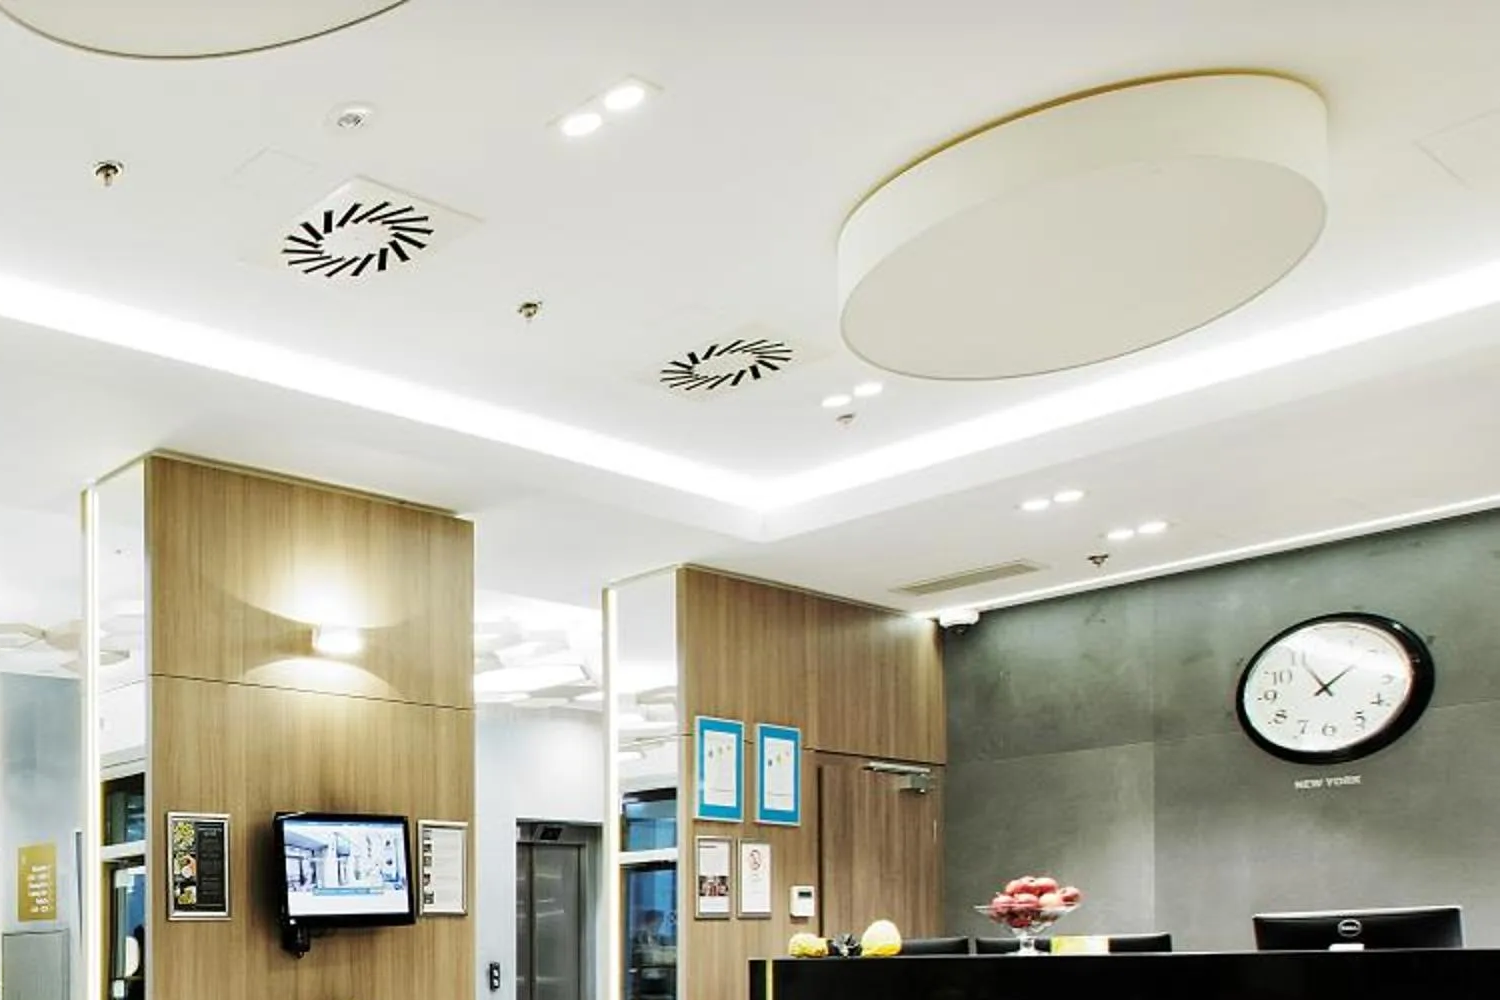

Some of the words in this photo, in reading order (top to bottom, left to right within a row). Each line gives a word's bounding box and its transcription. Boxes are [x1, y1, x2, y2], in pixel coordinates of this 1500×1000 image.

[1272, 669, 1293, 686] 10
[1263, 689, 1278, 701] 9
[1371, 692, 1385, 706] 4
[1275, 709, 1288, 725] 8
[1355, 709, 1366, 732] 5
[1298, 719, 1309, 735] 7
[1322, 722, 1337, 737] 6
[1294, 778, 1323, 790] NEW
[1325, 775, 1361, 788] YORK
